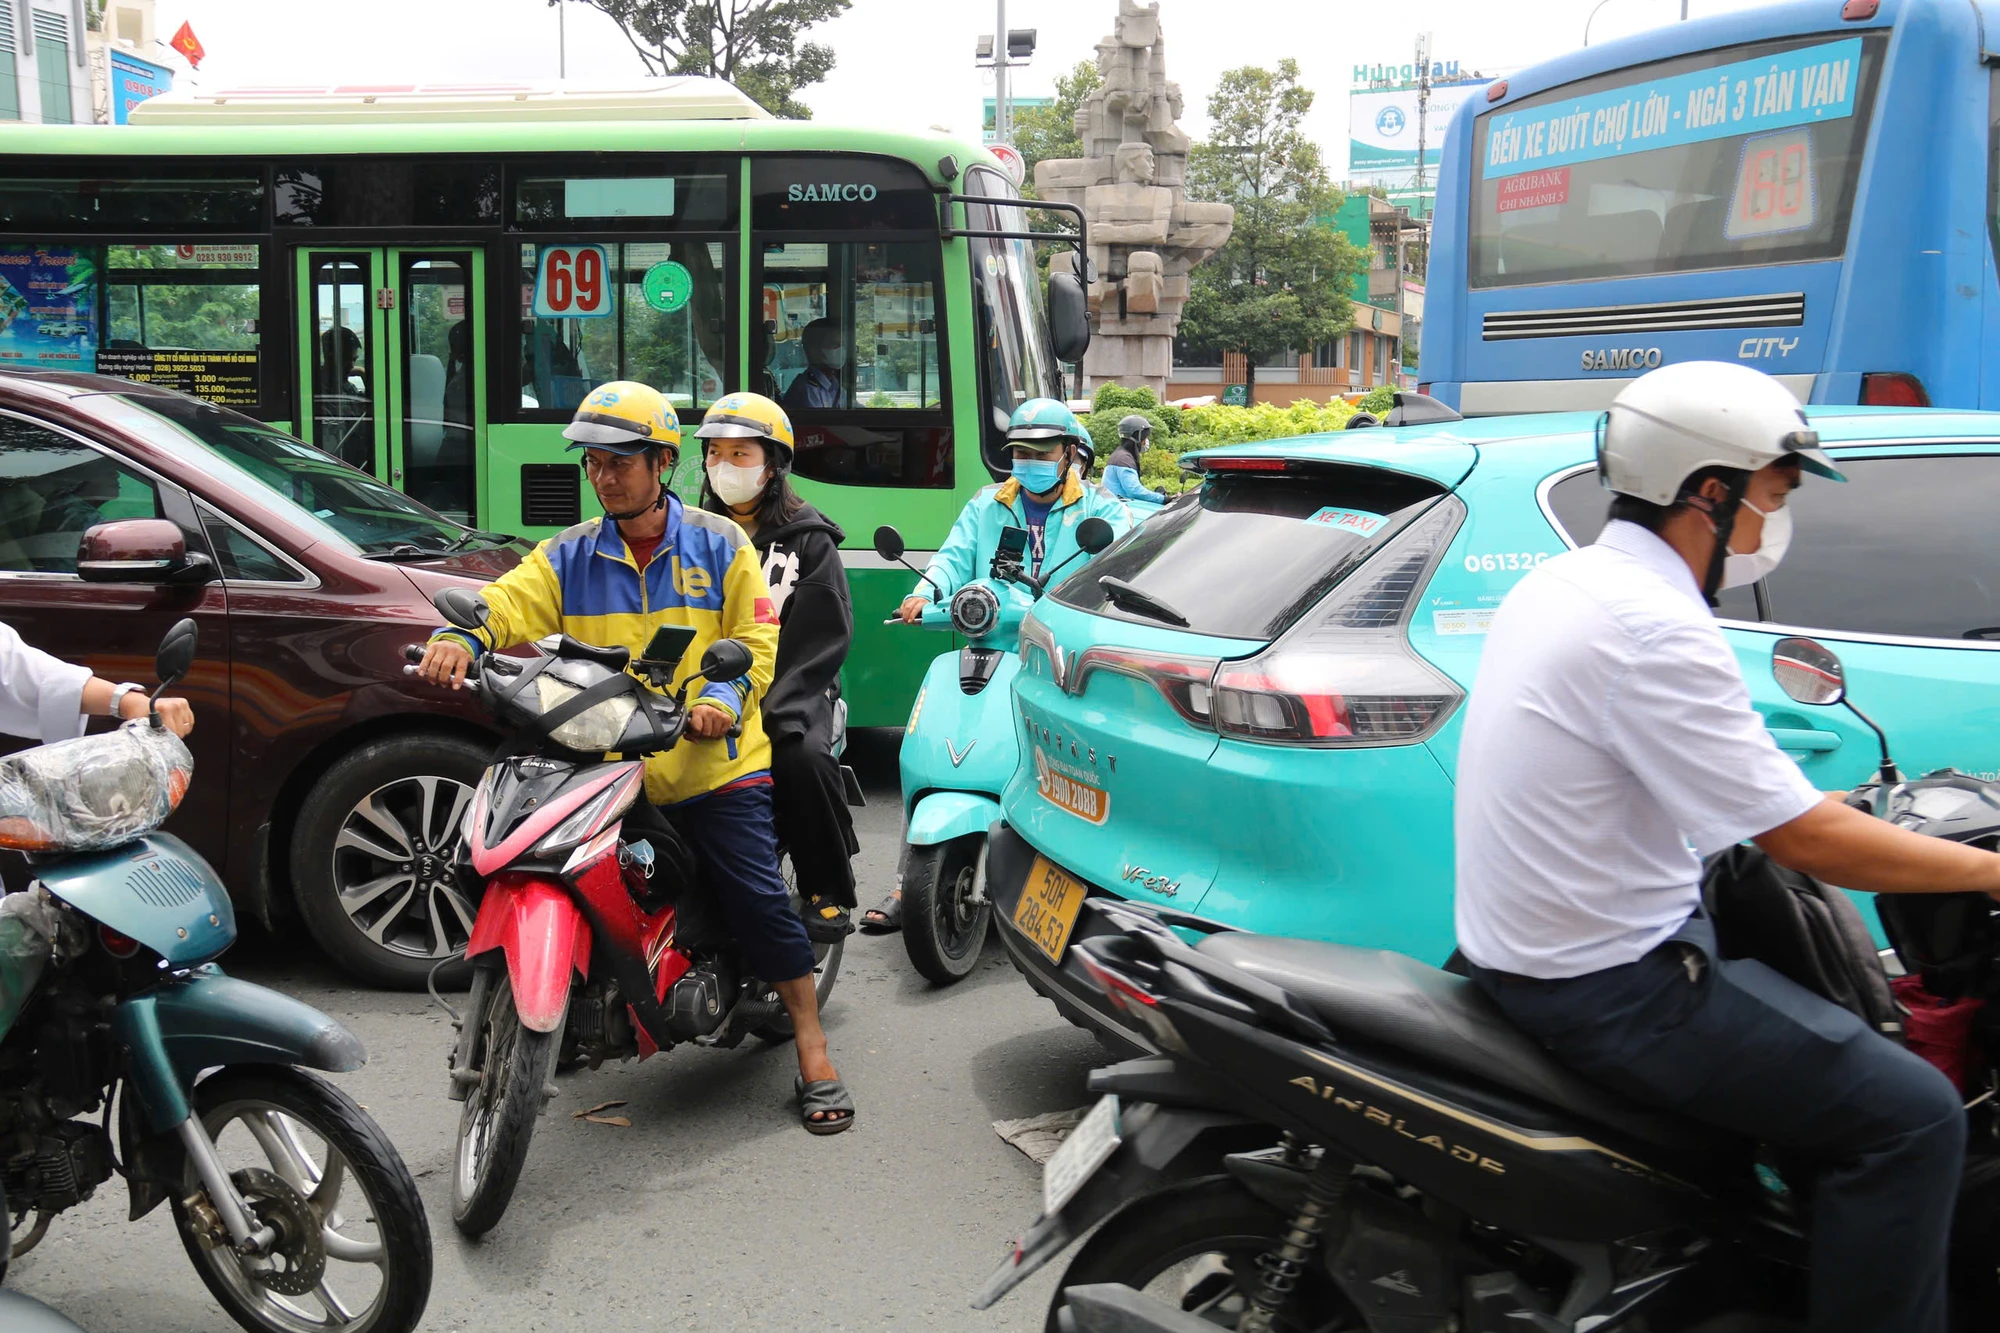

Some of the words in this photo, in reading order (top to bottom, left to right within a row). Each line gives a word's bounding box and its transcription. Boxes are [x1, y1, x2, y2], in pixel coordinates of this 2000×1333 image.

[1490, 117, 1522, 166] BẾN
[1523, 121, 1545, 160] XE
[1547, 106, 1590, 155] BUÝT
[1593, 100, 1631, 150] CHỢ
[1631, 90, 1670, 139] LỚN
[1685, 75, 1728, 129] NGÃ
[1732, 79, 1747, 121] 3
[1752, 64, 1796, 117] TÂN
[1801, 58, 1849, 116] VẠN
[788, 183, 877, 201] SAMCO
[1504, 171, 1562, 193] AGRIBANK
[1500, 199, 1518, 211] CHI
[1519, 193, 1556, 207] NHÁNH
[1557, 191, 1564, 202] 5
[197, 253, 215, 262] 0283
[217, 253, 231, 262] 930
[233, 253, 252, 261] 9912
[547, 249, 601, 311] 69
[1581, 347, 1662, 370] SAMCO
[1738, 337, 1799, 359] CITY
[194, 374, 216, 382] 3.000
[195, 385, 226, 393] 135.000
[1314, 511, 1340, 523] XE
[1338, 513, 1378, 532] TAXI
[671, 555, 712, 598] be
[1051, 773, 1070, 806] 1900
[1071, 782, 1097, 817] 2088
[422, 856, 433, 876] KIA
[1040, 868, 1070, 912] 50H
[1018, 896, 1064, 953] 284.53
